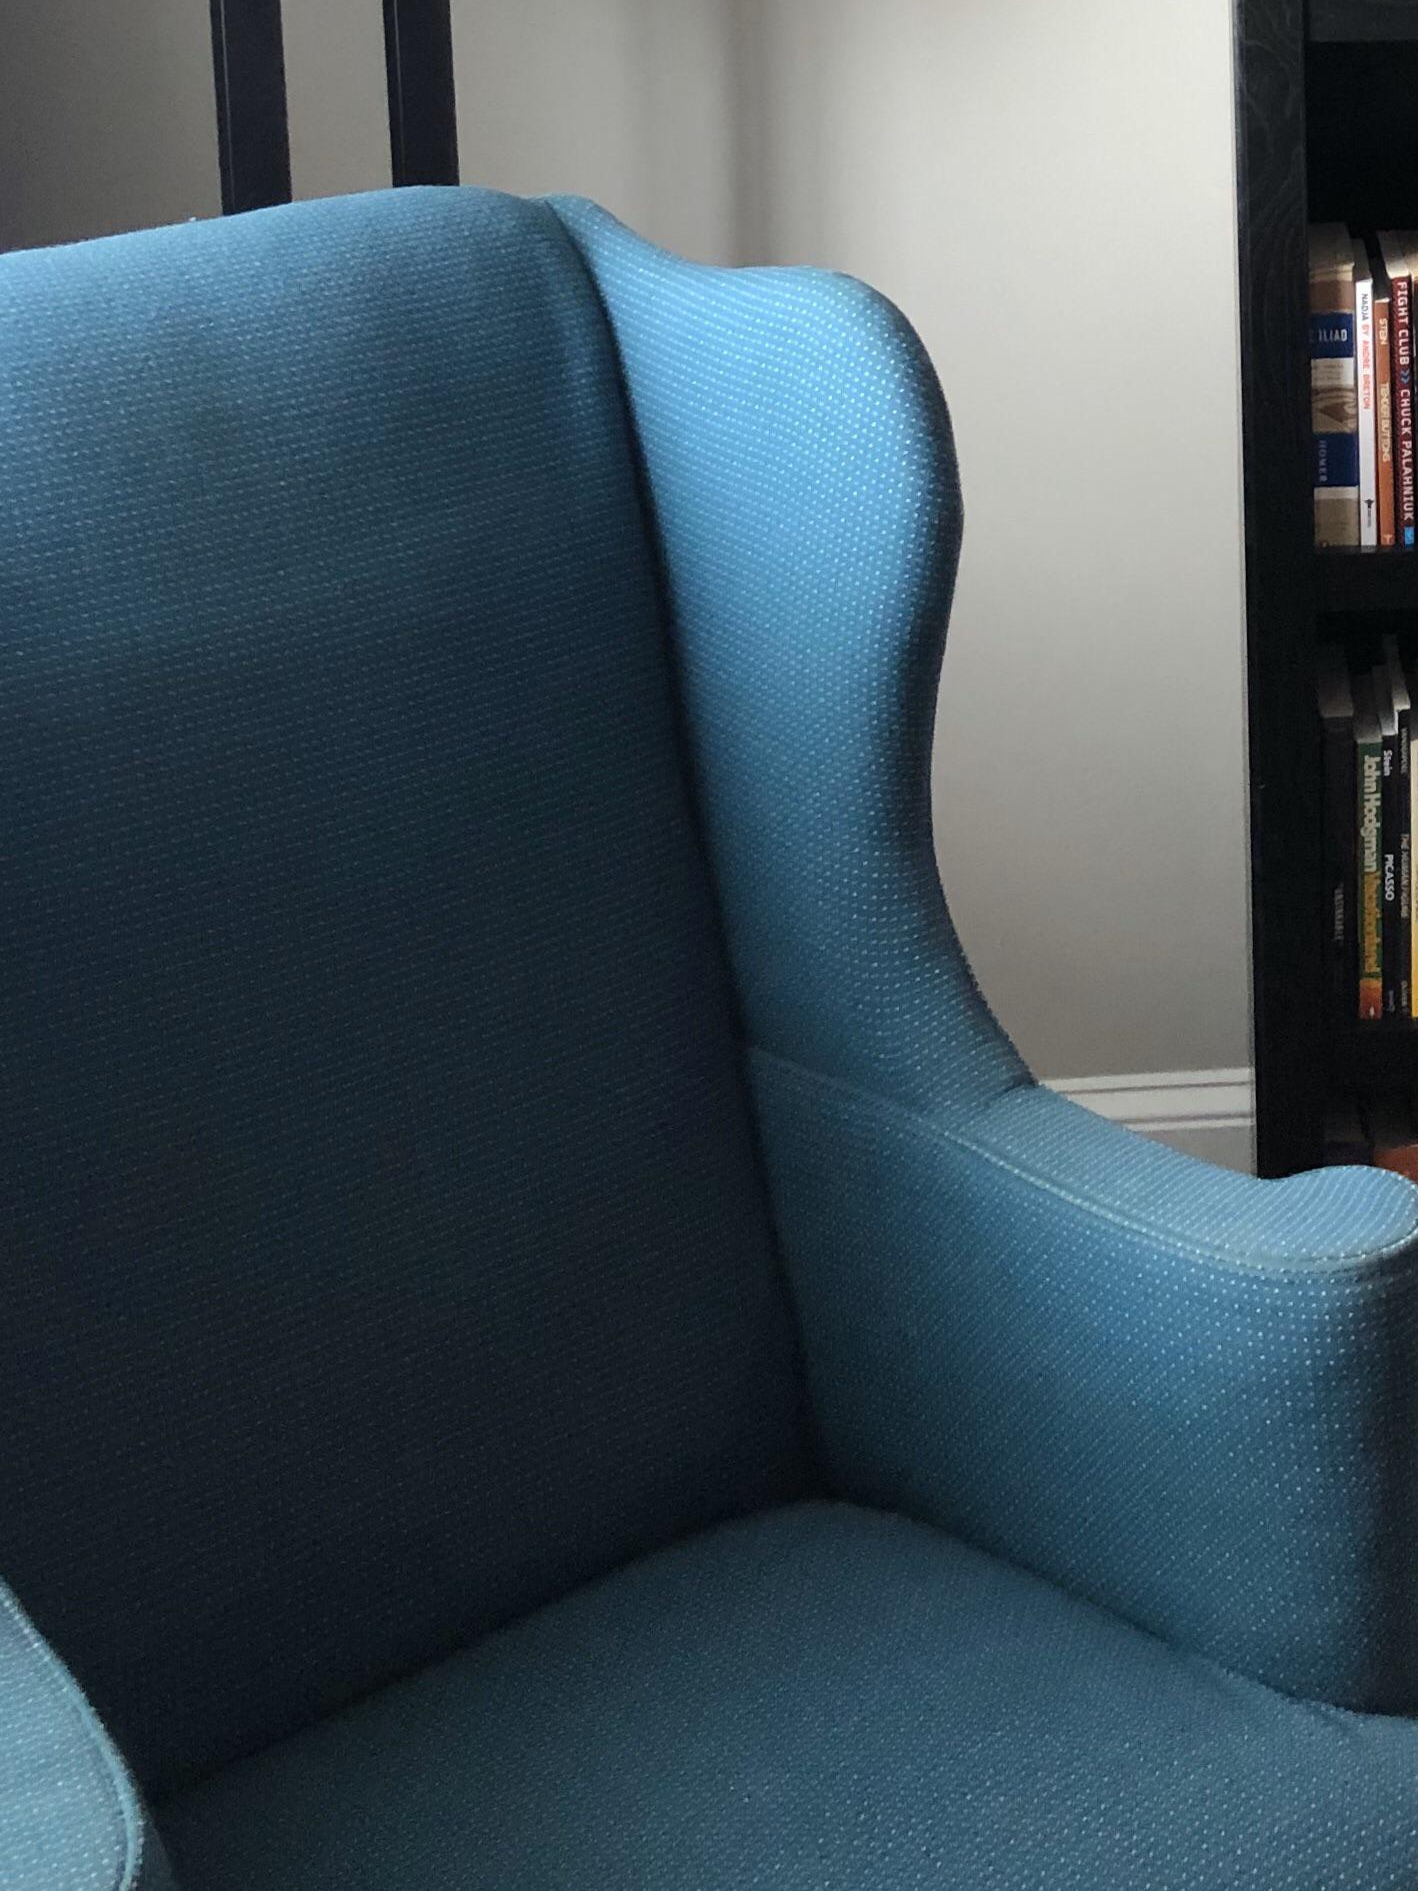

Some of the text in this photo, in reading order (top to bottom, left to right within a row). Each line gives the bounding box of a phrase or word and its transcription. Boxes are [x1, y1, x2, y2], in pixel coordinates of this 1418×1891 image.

[1397, 282, 1413, 521] FIGHT CLUB CHUCK PALAHNIUK
[1383, 750, 1393, 776] Stein
[1360, 755, 1381, 872] John Hodgman
[1385, 854, 1395, 901] PICASSO
